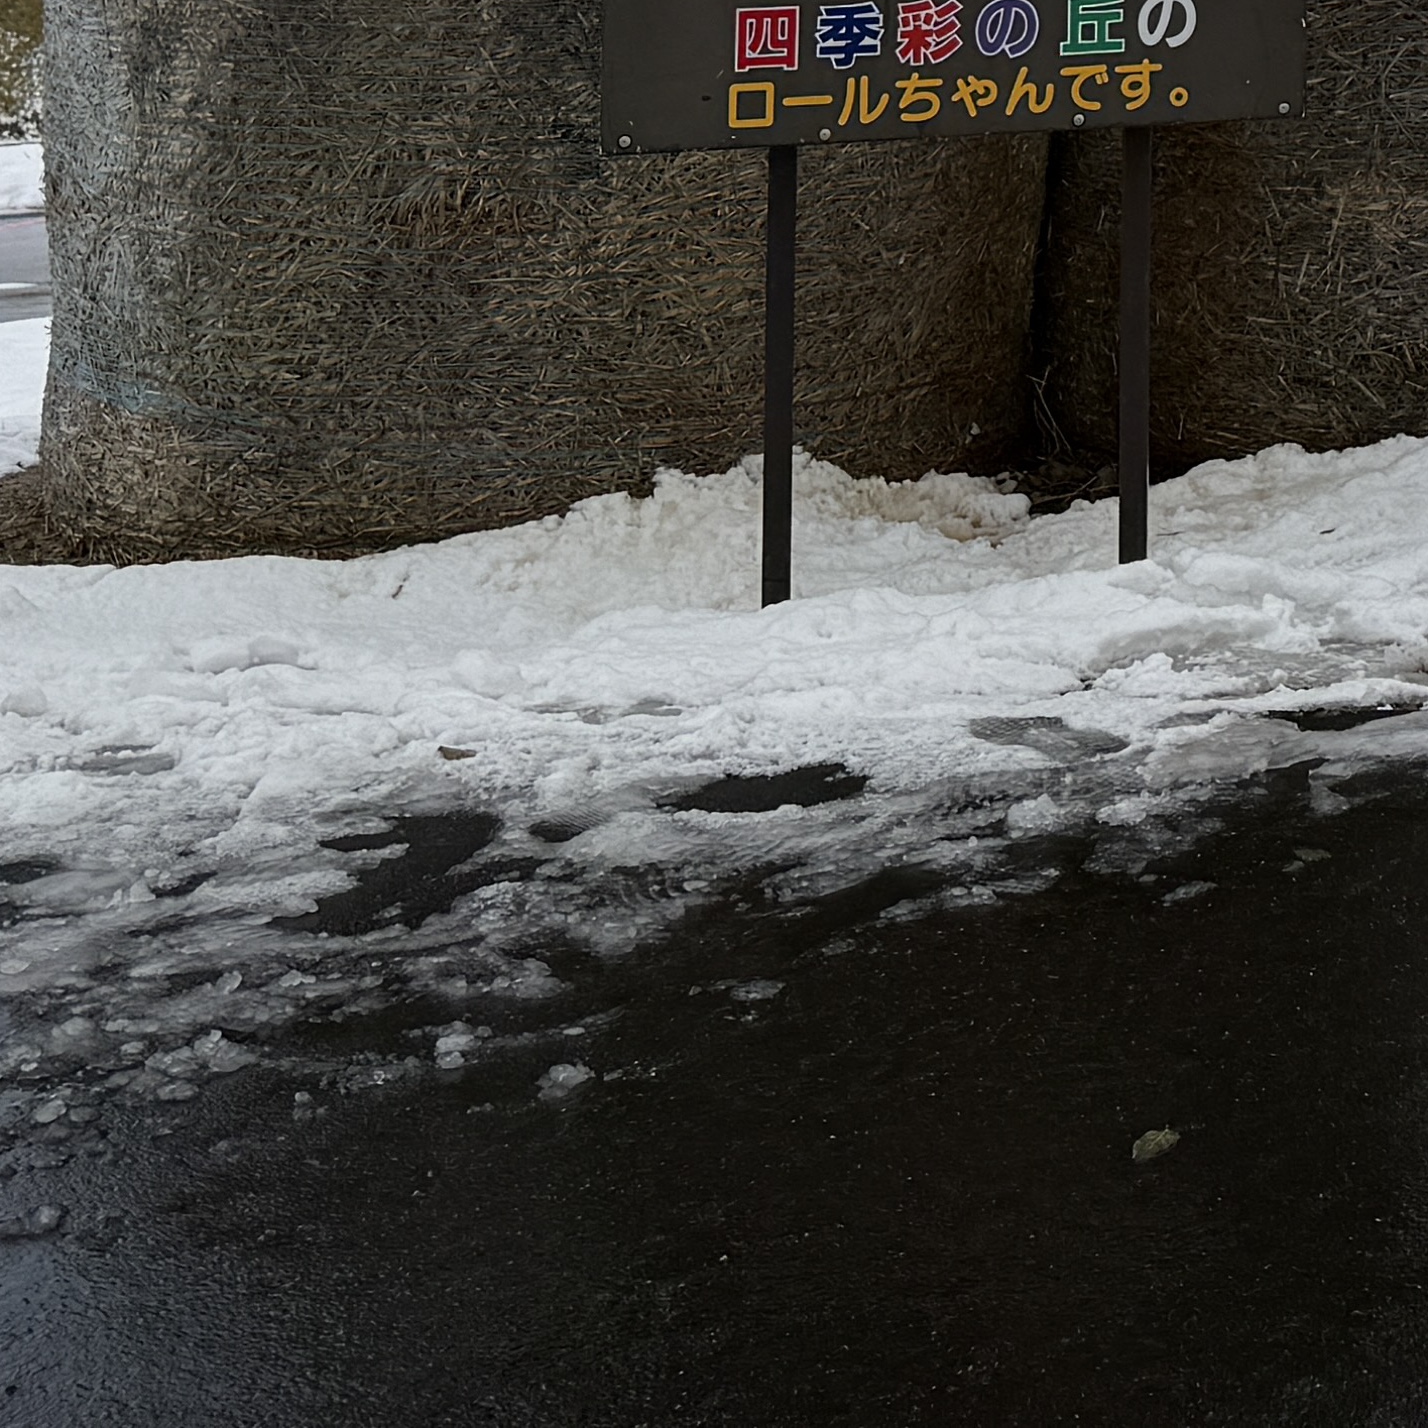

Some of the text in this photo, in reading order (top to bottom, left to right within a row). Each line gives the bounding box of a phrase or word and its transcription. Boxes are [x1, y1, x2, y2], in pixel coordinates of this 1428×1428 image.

[728, 58, 1189, 128] ロールちゃんです。
